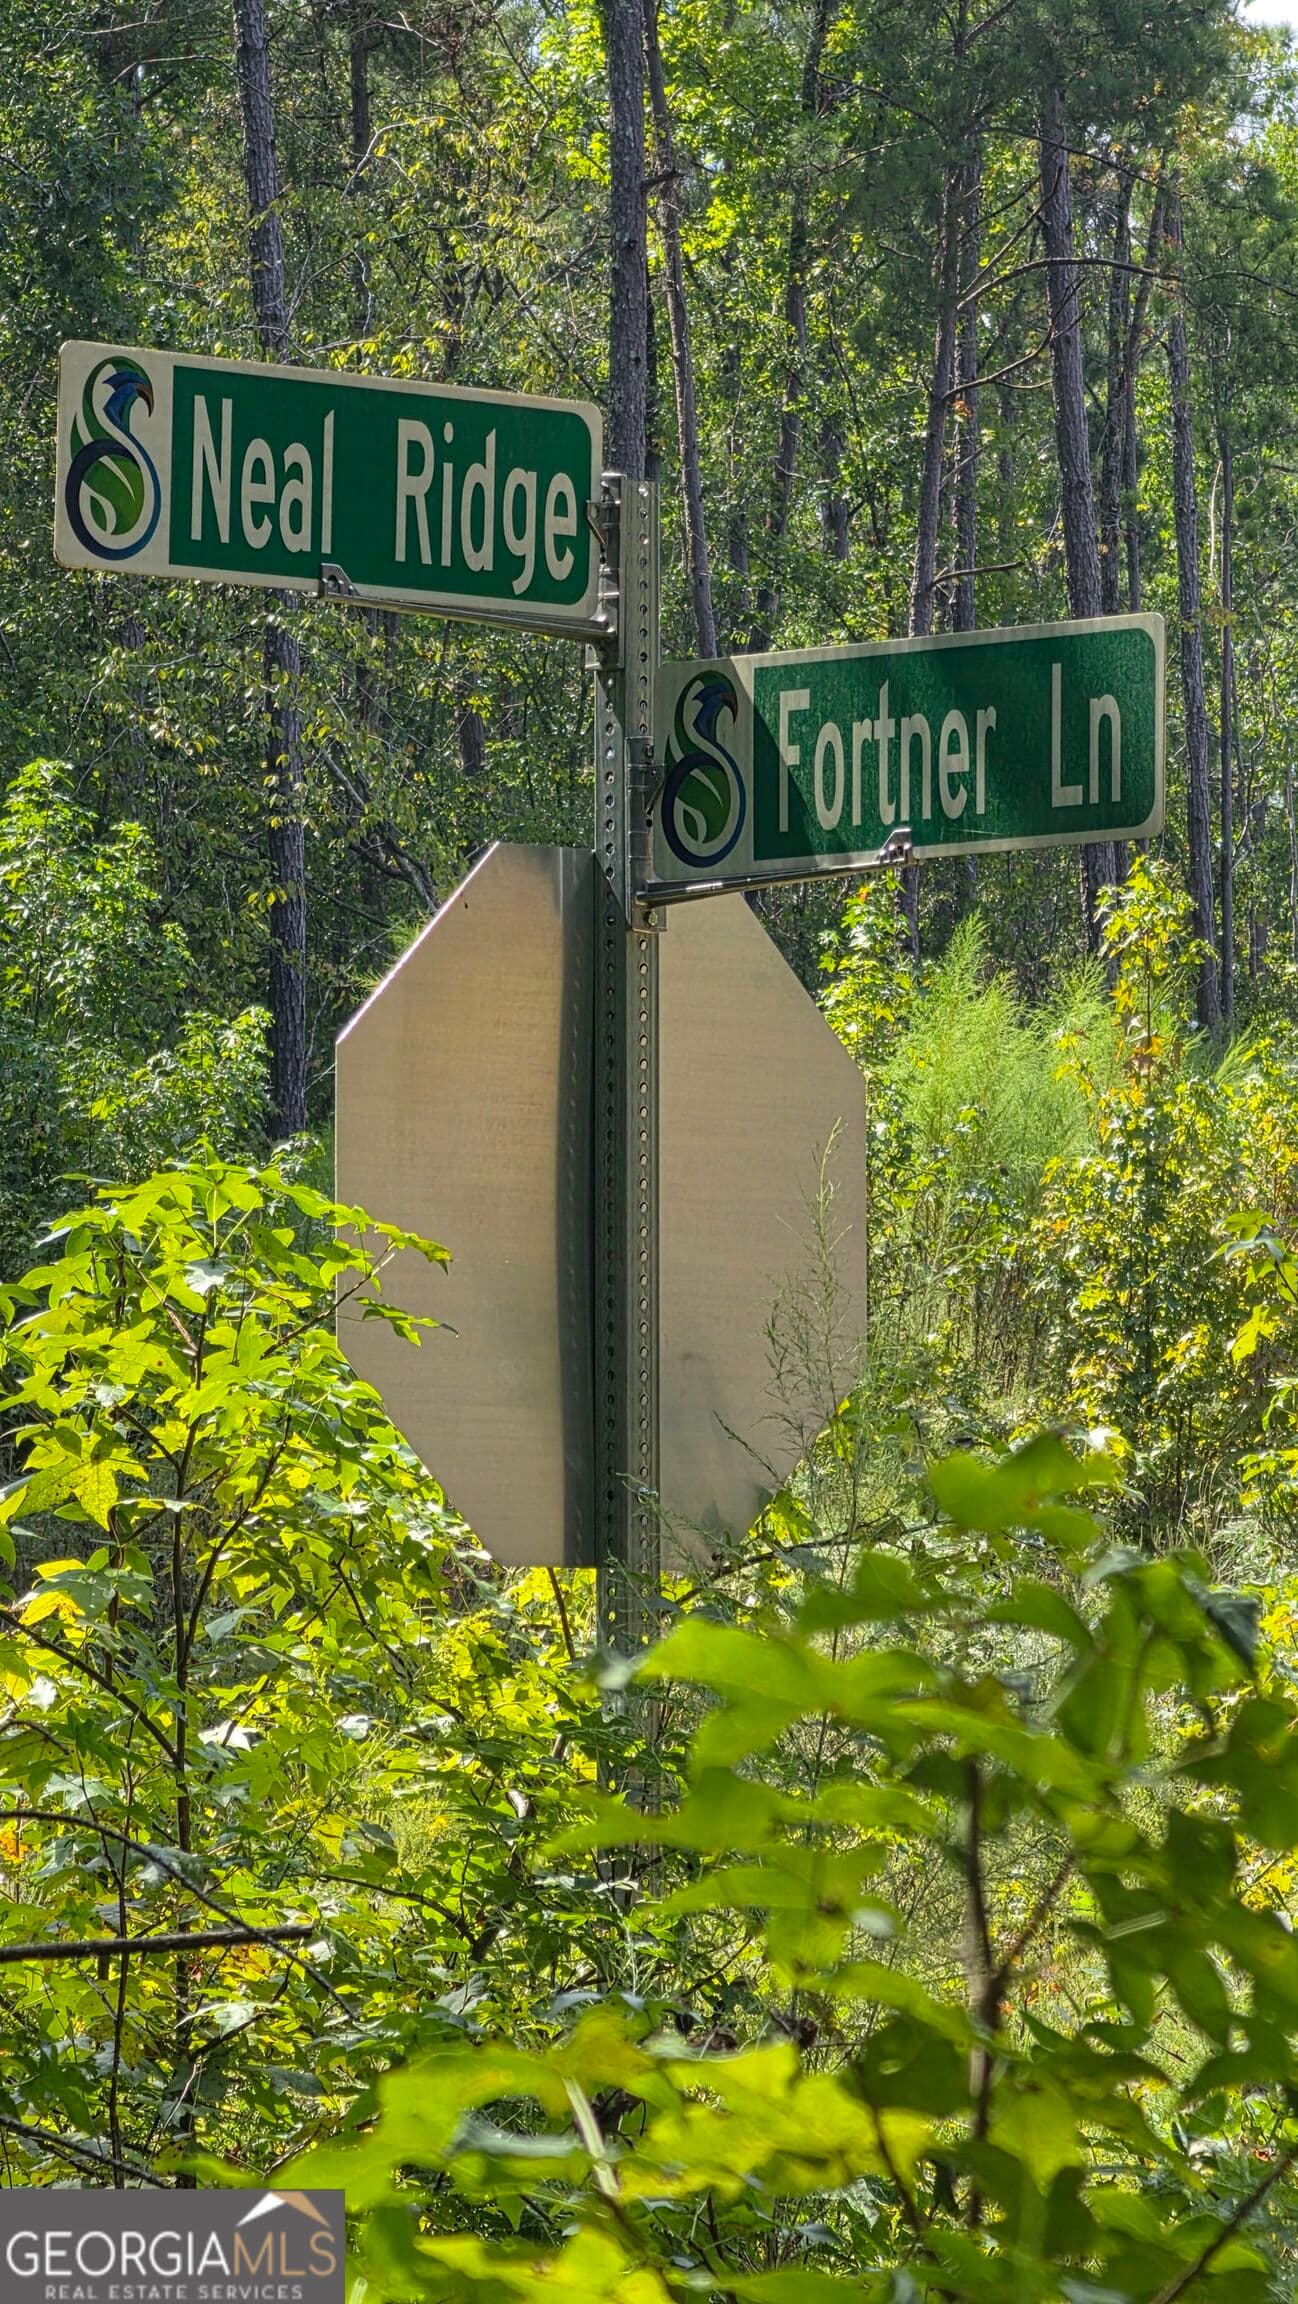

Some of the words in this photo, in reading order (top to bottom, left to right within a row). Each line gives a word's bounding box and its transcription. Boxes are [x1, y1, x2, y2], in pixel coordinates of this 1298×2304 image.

[190, 394, 336, 555] Neal
[394, 417, 578, 596] Ridge
[778, 678, 998, 833] Fortner
[1050, 662, 1123, 809] Ln
